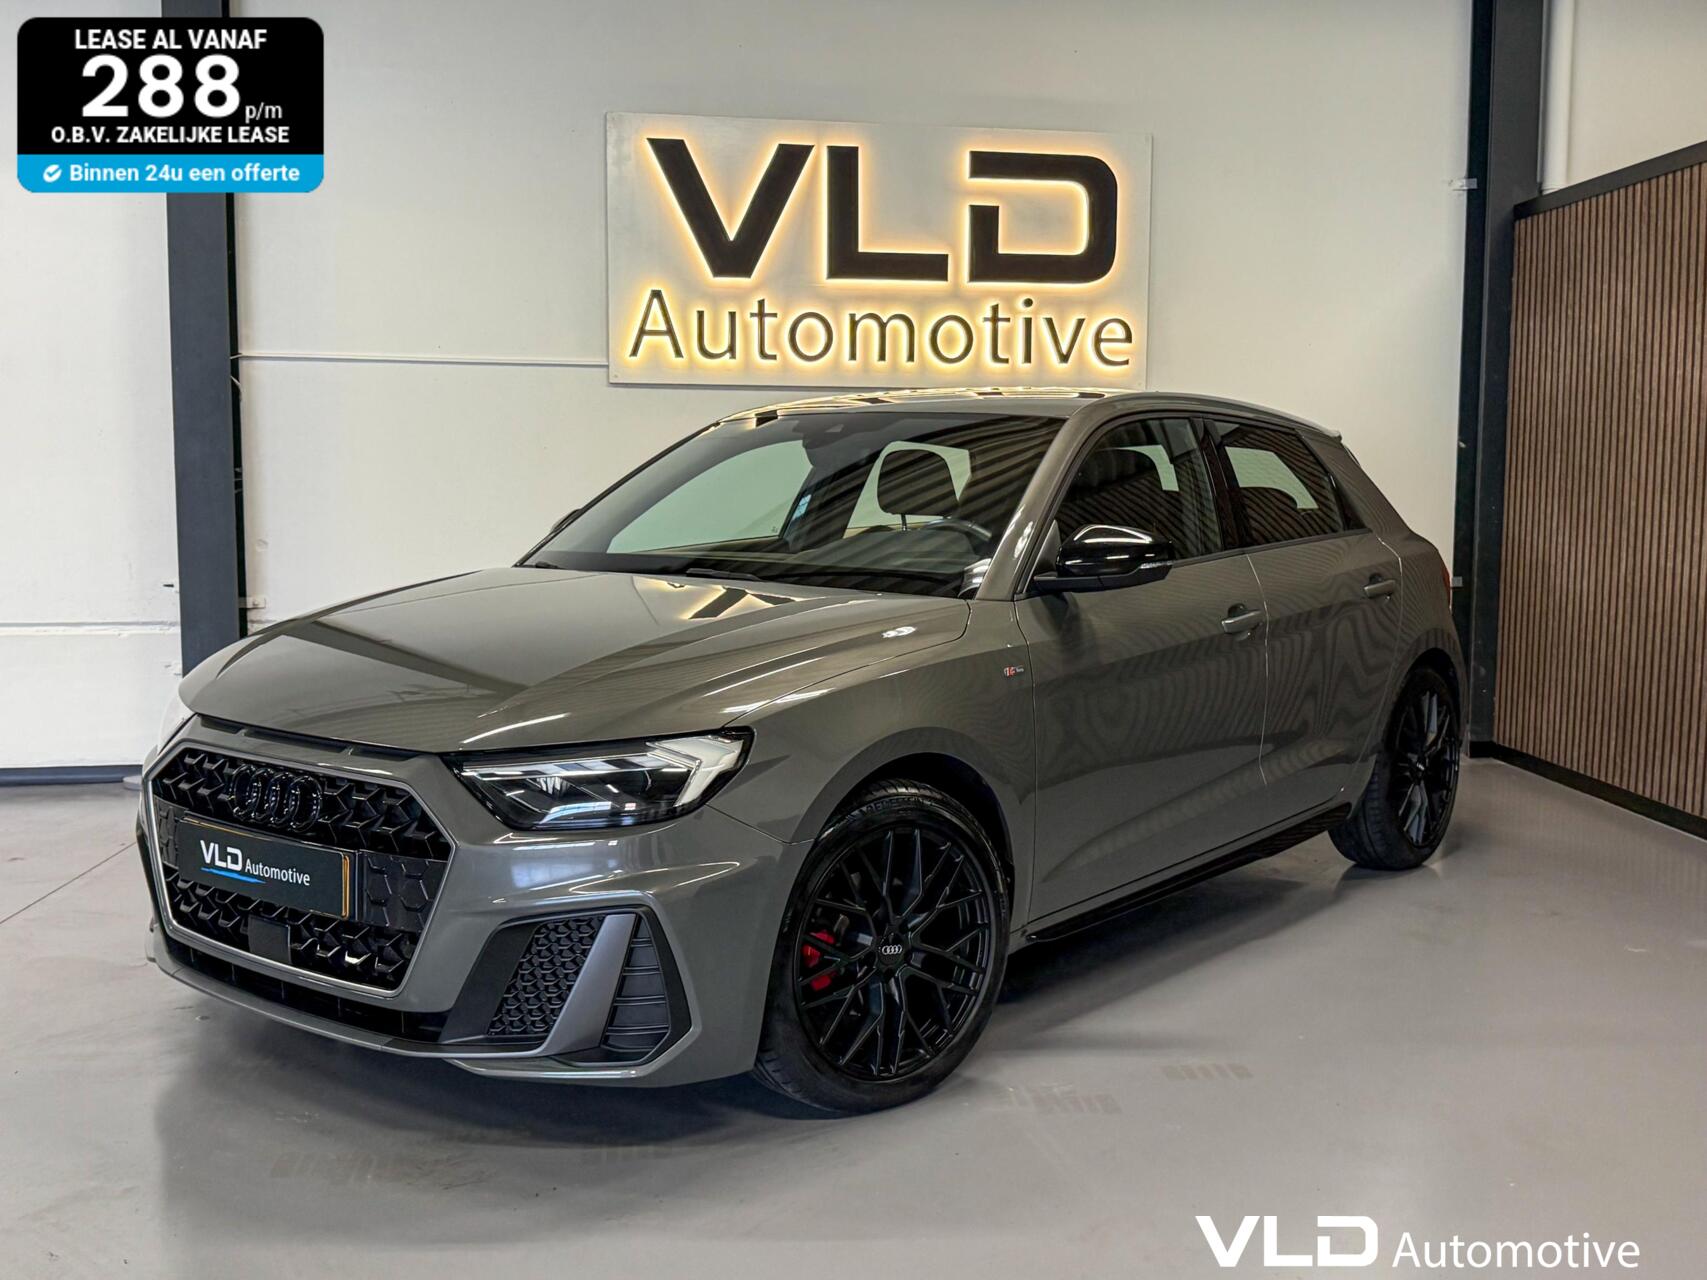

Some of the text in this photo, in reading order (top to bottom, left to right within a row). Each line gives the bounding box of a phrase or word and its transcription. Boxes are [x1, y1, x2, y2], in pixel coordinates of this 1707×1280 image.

[646, 137, 1118, 284] VLD
[629, 289, 1133, 366] Automotive
[200, 840, 311, 886] VLD Automotive
